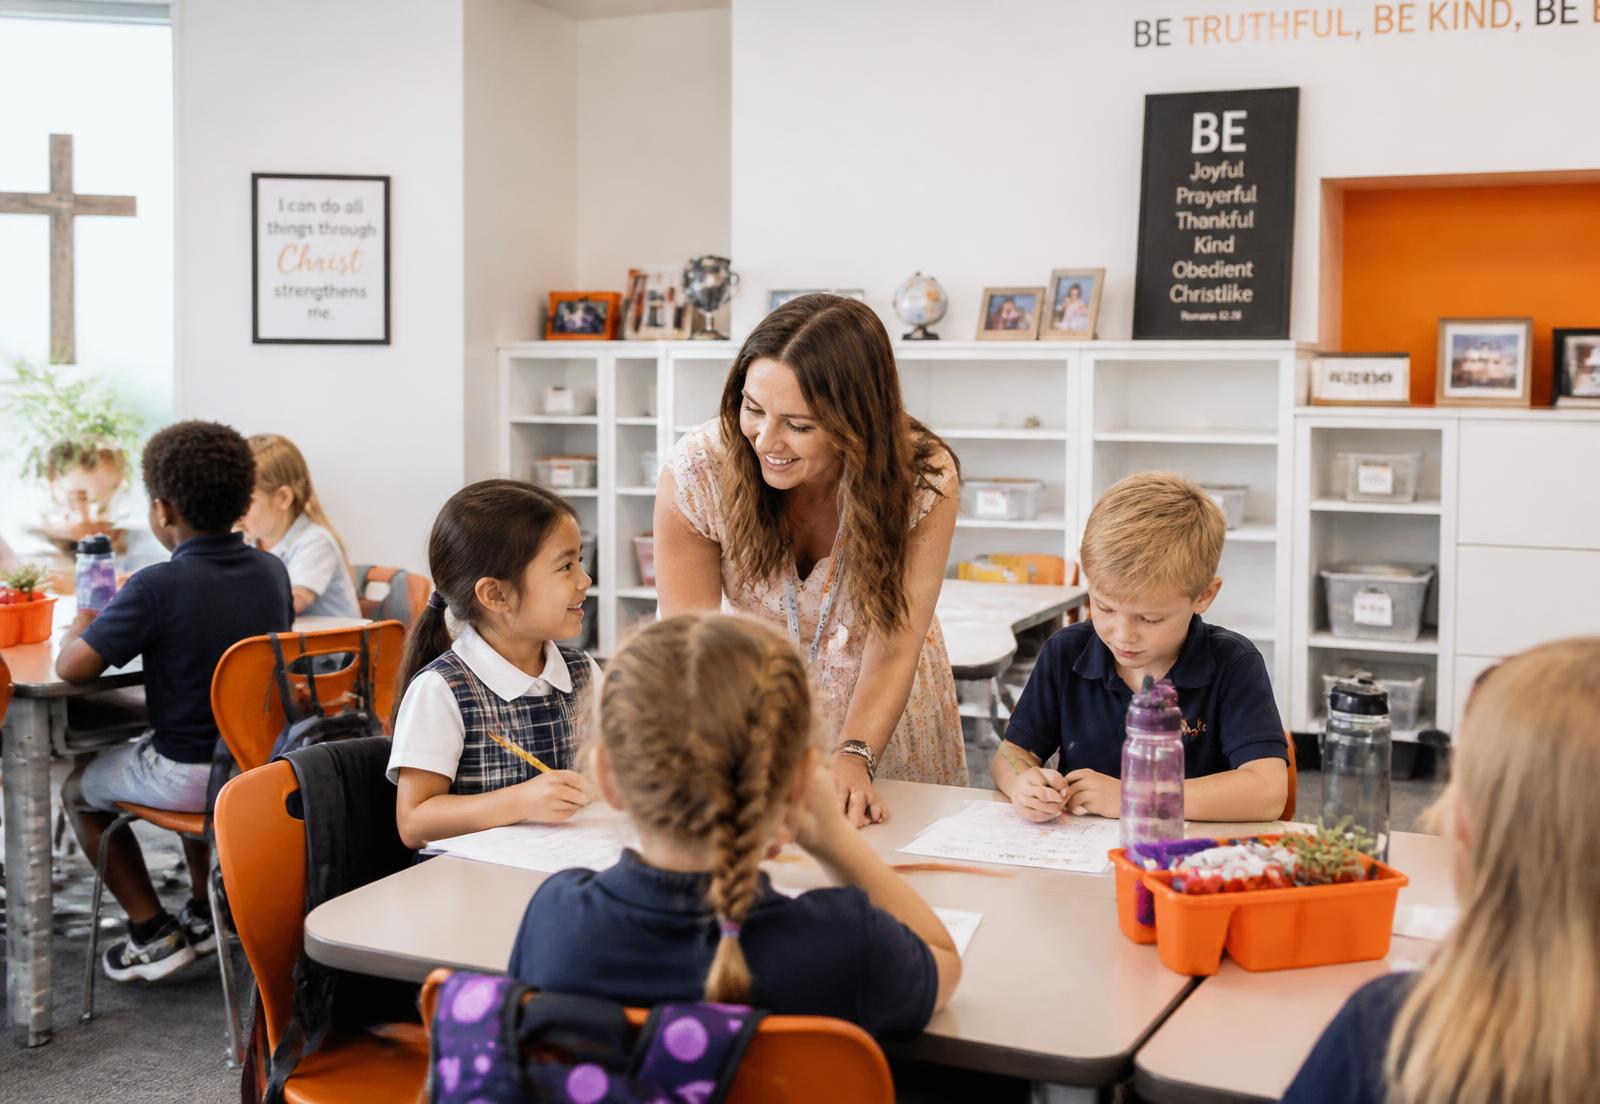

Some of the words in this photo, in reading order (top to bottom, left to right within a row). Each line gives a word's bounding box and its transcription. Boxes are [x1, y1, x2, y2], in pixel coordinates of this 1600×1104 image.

[1134, 18, 1171, 47] BE
[1183, 7, 1361, 46] TRUTHFUL,
[1374, 3, 1416, 34] BE
[1428, 0, 1521, 32] KIND,
[1535, 0, 1579, 26] BE
[1191, 110, 1247, 153] BE
[1189, 160, 1245, 184] Joyful
[1176, 184, 1258, 208] Prayerful
[287, 201, 316, 213] can
[320, 199, 341, 214] do
[344, 199, 364, 214] all
[267, 220, 314, 239] things
[318, 220, 376, 240] through
[1176, 210, 1255, 230] Thankful
[1194, 235, 1235, 254] Kind
[275, 242, 365, 274] Christ
[1172, 260, 1253, 279] Obedient
[273, 283, 367, 301] strengthens
[1169, 284, 1253, 304] Christlike
